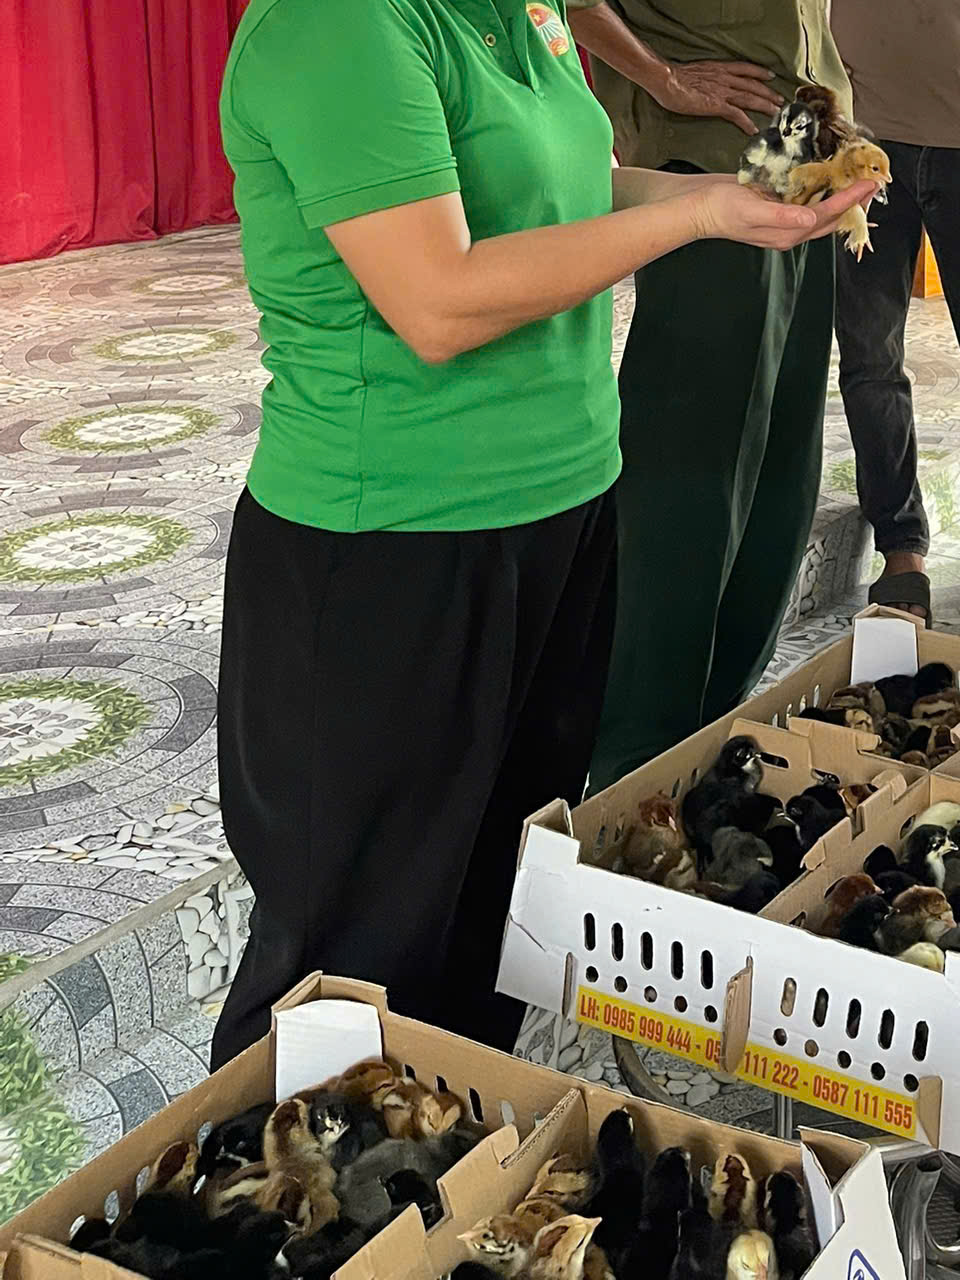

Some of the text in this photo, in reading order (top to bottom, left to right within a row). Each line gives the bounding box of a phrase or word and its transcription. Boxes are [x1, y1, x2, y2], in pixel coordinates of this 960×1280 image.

[579, 994, 600, 1022] LH:
[603, 1003, 636, 1034] 0985
[639, 1015, 664, 1043] 999
[666, 1025, 691, 1054] 444
[705, 1037, 722, 1064] 05
[744, 1050, 768, 1080] 111
[772, 1060, 799, 1090] 222
[812, 1074, 849, 1107] 0587
[854, 1089, 879, 1119] 111
[884, 1099, 913, 1130] 555
